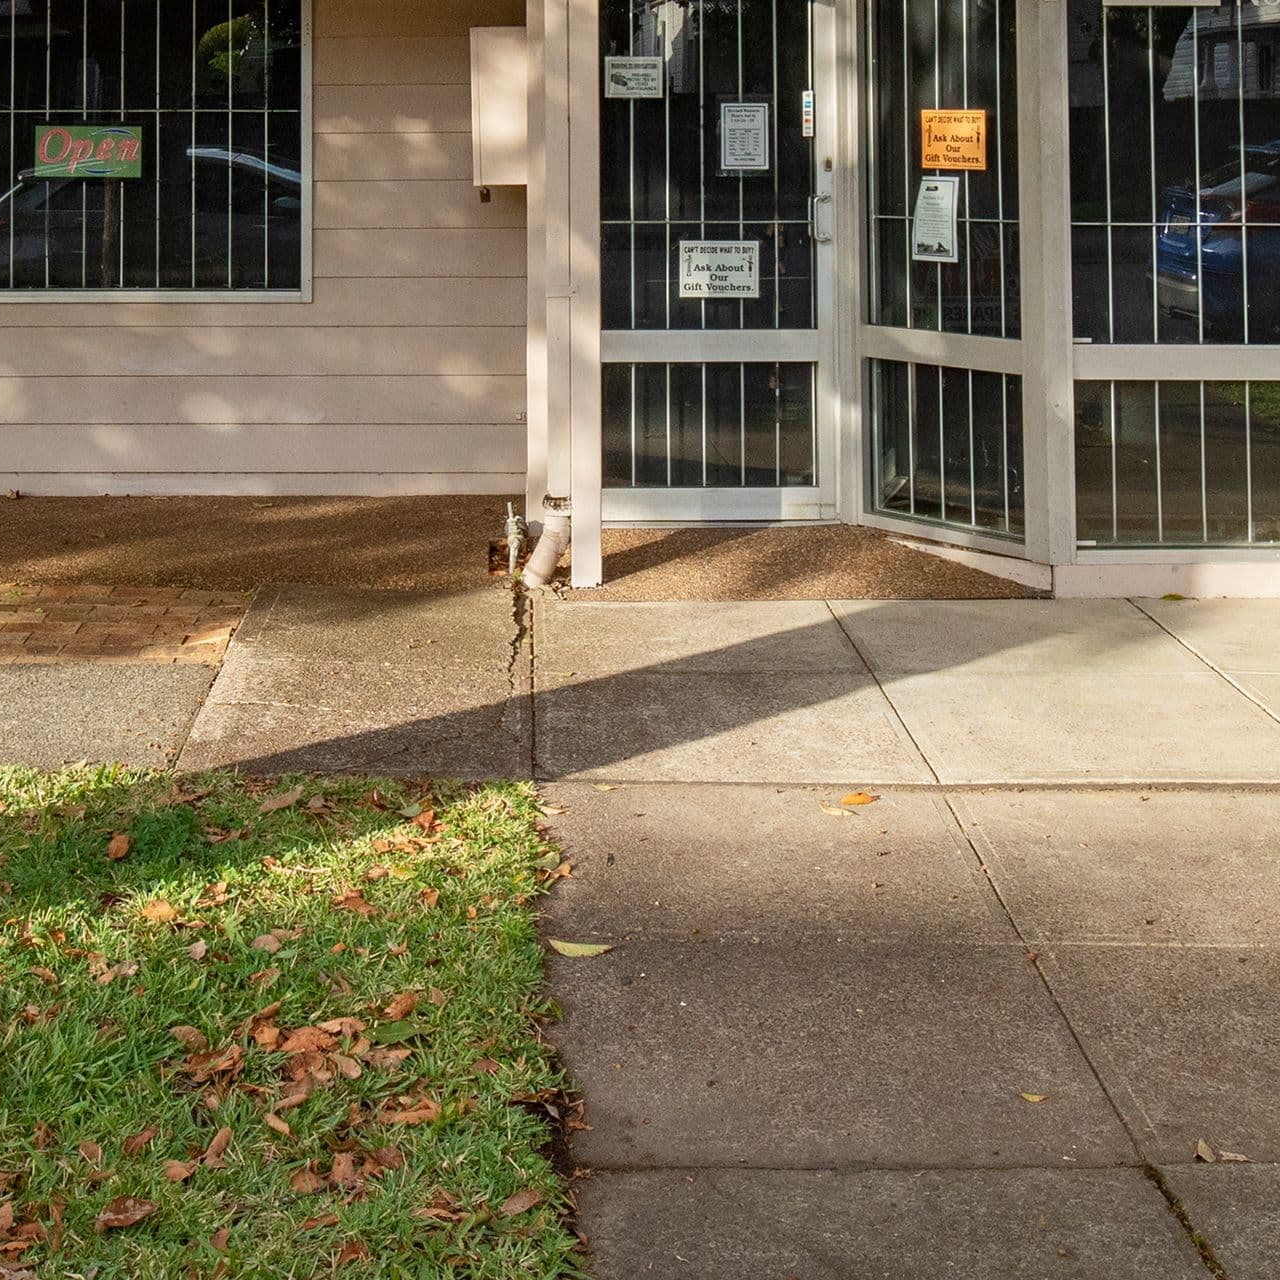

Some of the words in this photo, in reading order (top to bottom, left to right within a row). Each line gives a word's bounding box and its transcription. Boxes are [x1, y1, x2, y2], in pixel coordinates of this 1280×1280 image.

[933, 134, 947, 142] Ask
[950, 134, 974, 143] About
[38, 127, 140, 174] Open
[946, 144, 961, 153] Our
[925, 153, 940, 162] Gift
[693, 264, 712, 272] Ask
[715, 264, 744, 272] About
[710, 273, 728, 282] Our
[683, 282, 702, 292] Gift
[706, 282, 754, 292] Vouchers.
